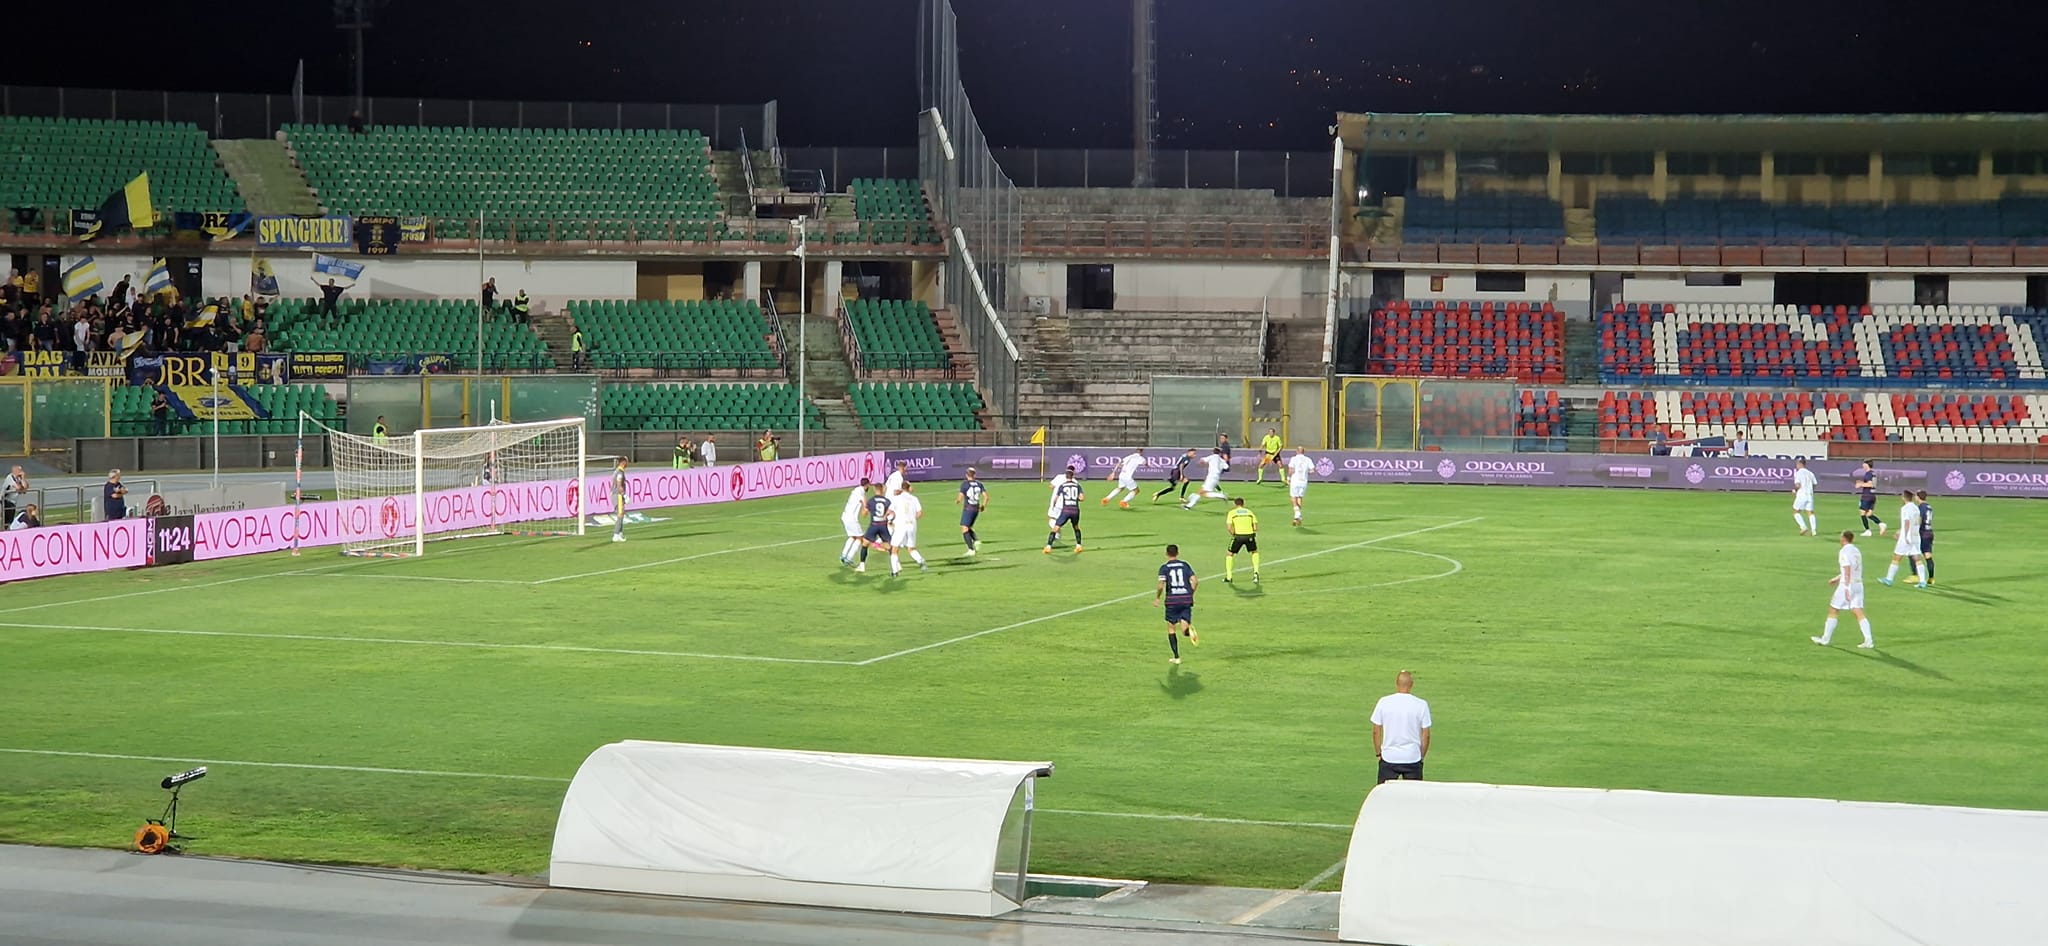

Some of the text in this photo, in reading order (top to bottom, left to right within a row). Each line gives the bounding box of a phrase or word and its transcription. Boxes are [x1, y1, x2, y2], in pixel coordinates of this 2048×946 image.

[24, 350, 63, 365] DAG
[1095, 456, 1176, 468] ODRDI
[1344, 459, 1424, 472] ODOARDI
[1465, 461, 1545, 473] ODOARDI
[747, 458, 861, 492] LAVORA CON NOI
[1975, 472, 2048, 486] ODOAR
[657, 475, 692, 501] CON
[697, 472, 725, 498] NOI
[1063, 486, 1078, 500] 30
[480, 488, 521, 518] CON
[527, 485, 558, 513] NOI
[875, 502, 885, 516] 9
[280, 509, 327, 542] CON
[336, 505, 372, 537] NOI
[31, 532, 82, 567] CON
[93, 525, 136, 561] NOI
[159, 526, 190, 552] 11:24
[1169, 568, 1185, 587] 11
